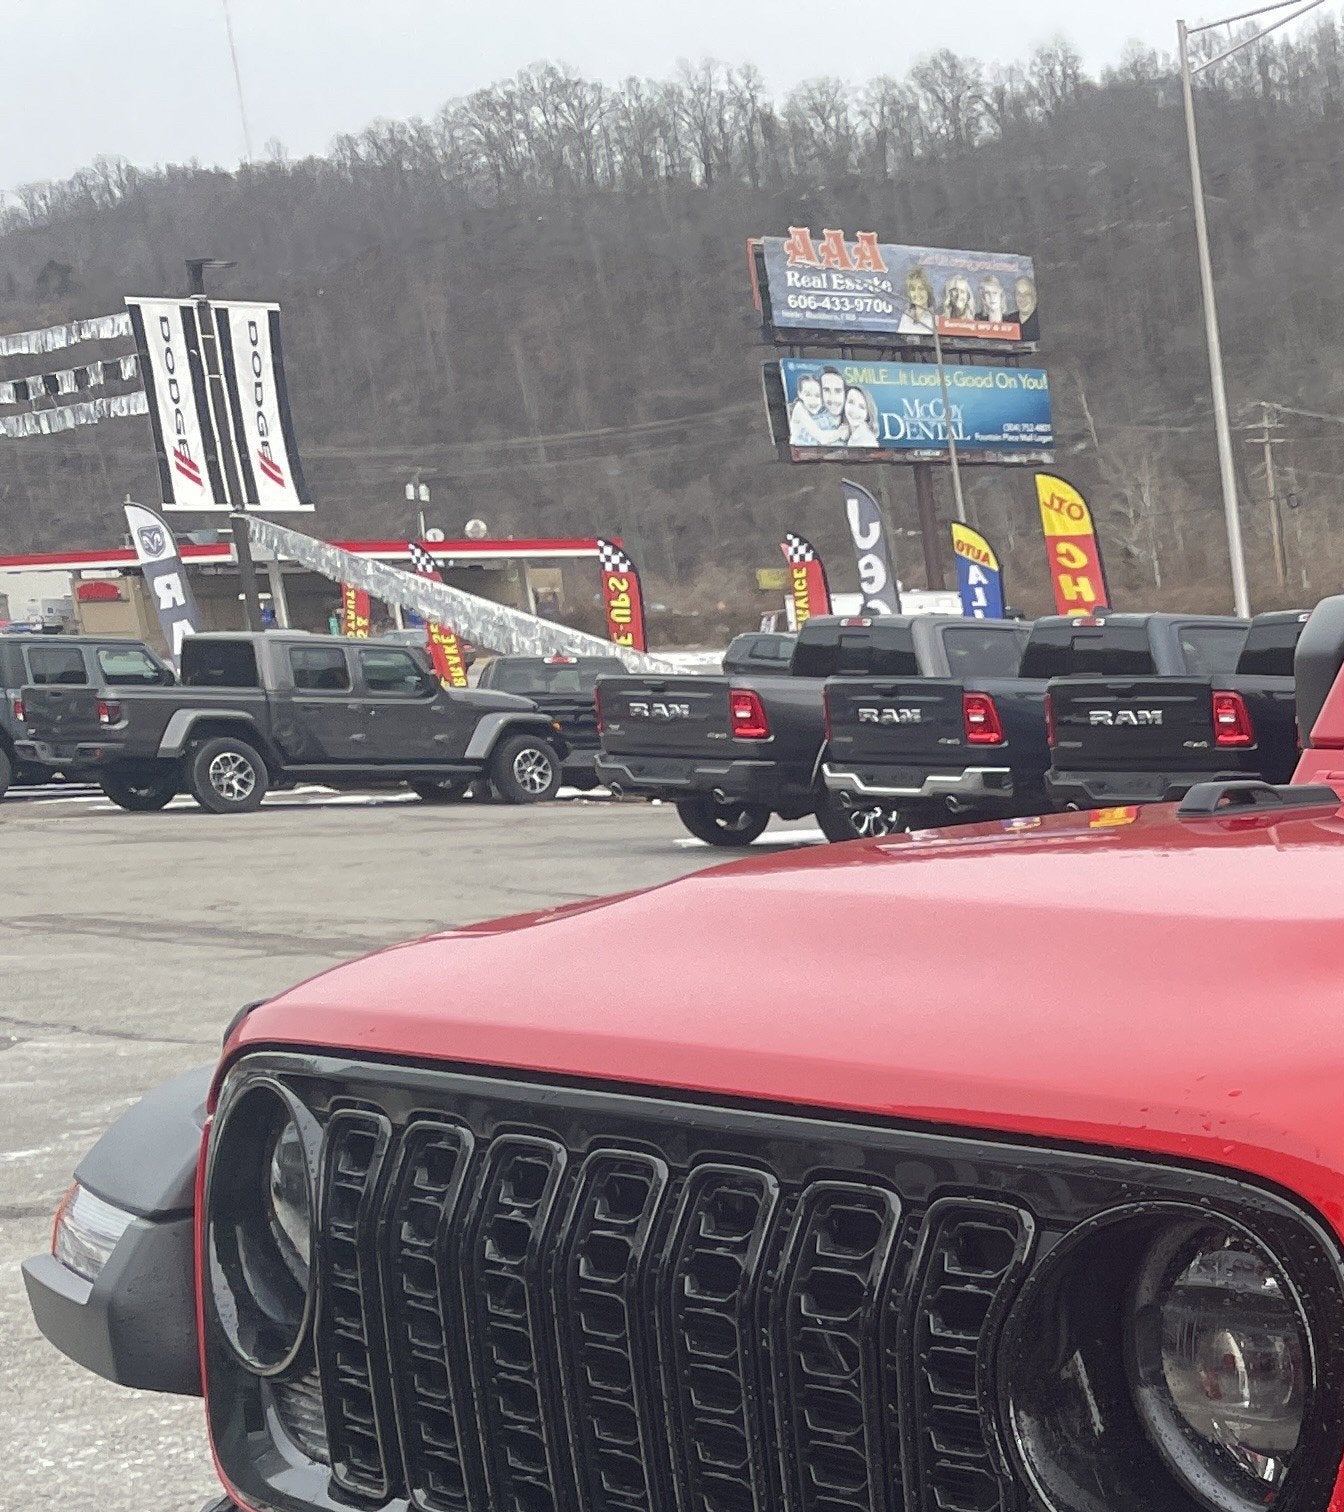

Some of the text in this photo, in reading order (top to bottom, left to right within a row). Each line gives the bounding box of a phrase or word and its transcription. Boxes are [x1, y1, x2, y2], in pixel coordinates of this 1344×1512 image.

[784, 226, 889, 273] AAA
[786, 271, 828, 289] Real
[953, 370, 993, 389] Good
[995, 372, 1017, 389] On
[159, 315, 192, 463] DODGE
[248, 320, 274, 464] DODGE
[629, 702, 690, 718] RAM
[858, 708, 922, 723] RAM
[1089, 709, 1163, 726] RAM
